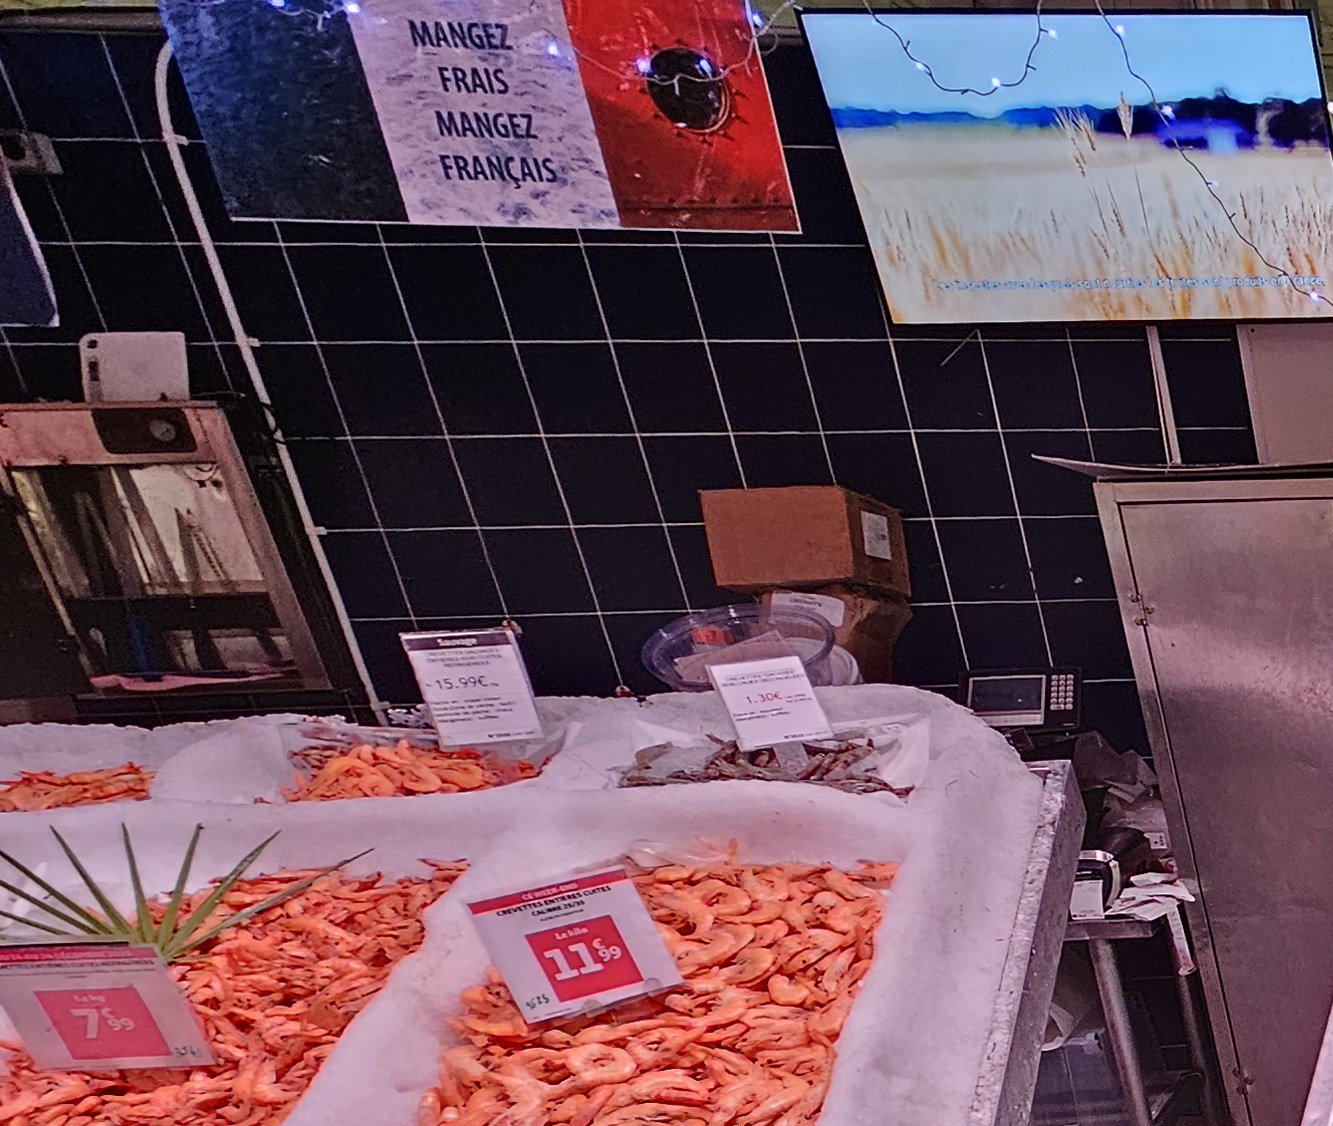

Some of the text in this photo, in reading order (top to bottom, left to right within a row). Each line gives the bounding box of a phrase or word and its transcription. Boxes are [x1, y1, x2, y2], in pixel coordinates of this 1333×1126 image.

[408, 20, 513, 50] MANGEZ
[438, 66, 509, 94] FRAIS
[435, 110, 539, 139] MANGEZ
[439, 154, 558, 189] FRANÇAIS
[436, 676, 488, 690] 15.99€
[746, 691, 784, 704] 1.30€
[496, 901, 543, 917] CREVETTES
[583, 885, 612, 897] CUITES
[554, 926, 589, 940] Le kilo
